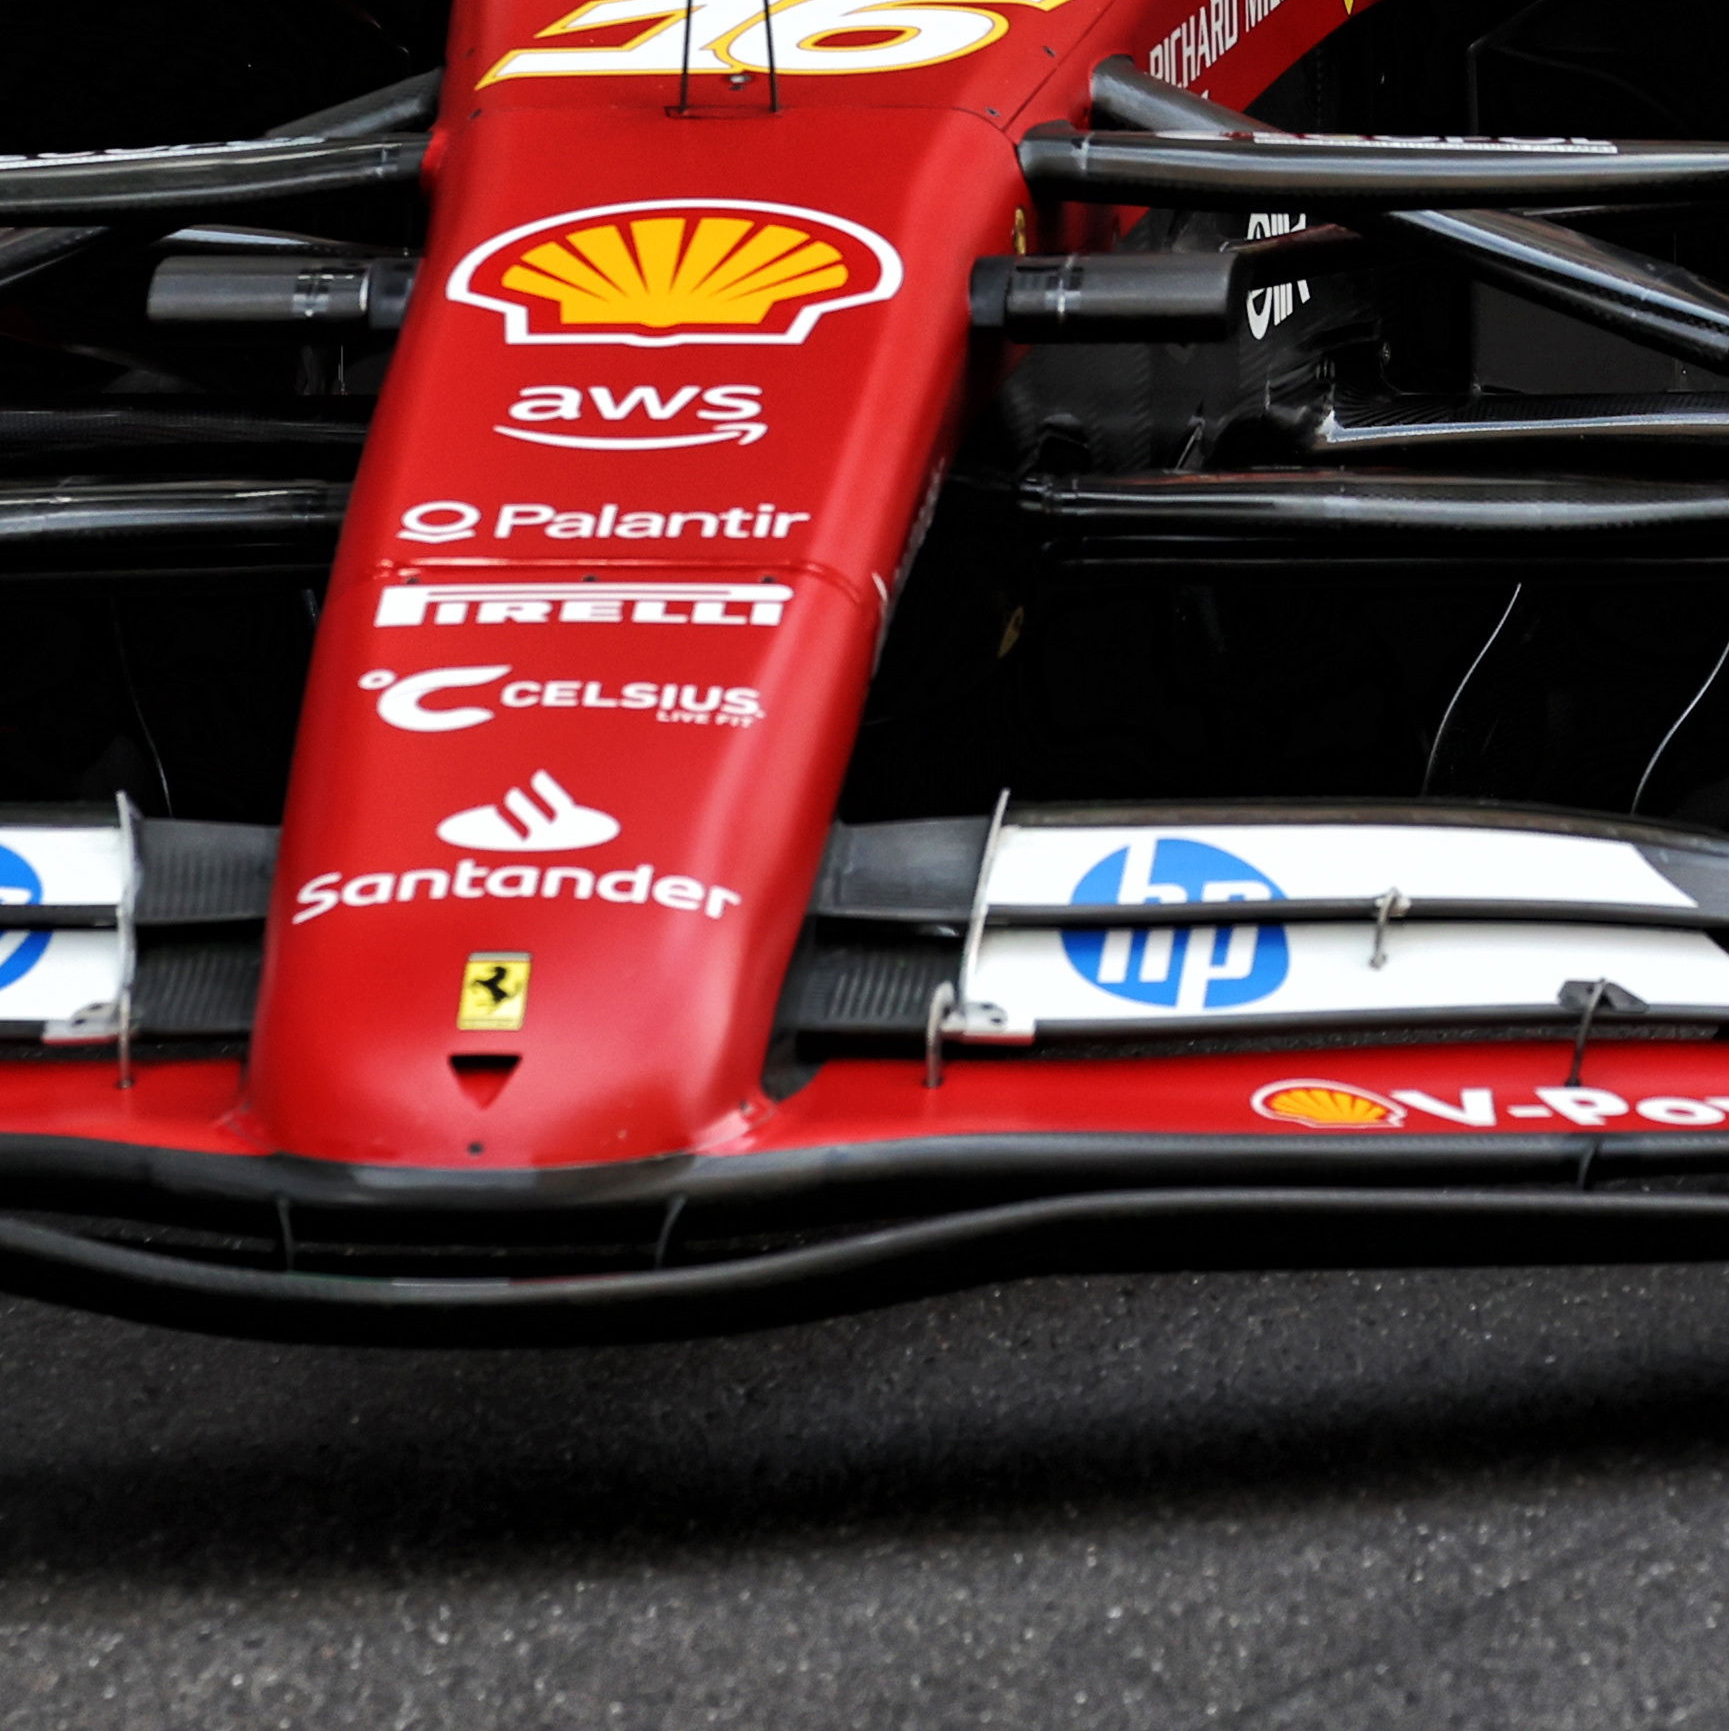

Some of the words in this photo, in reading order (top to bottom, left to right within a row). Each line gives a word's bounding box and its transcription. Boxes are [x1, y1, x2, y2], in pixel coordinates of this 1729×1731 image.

[508, 384, 763, 422] aws
[494, 503, 811, 539] Palantir
[374, 582, 795, 628] PIRELLI
[499, 679, 760, 716] CELSIUS
[655, 710, 710, 725] LIVE
[714, 712, 754, 729] FIT
[292, 857, 743, 924] Santander
[1095, 836, 1274, 1010] hp
